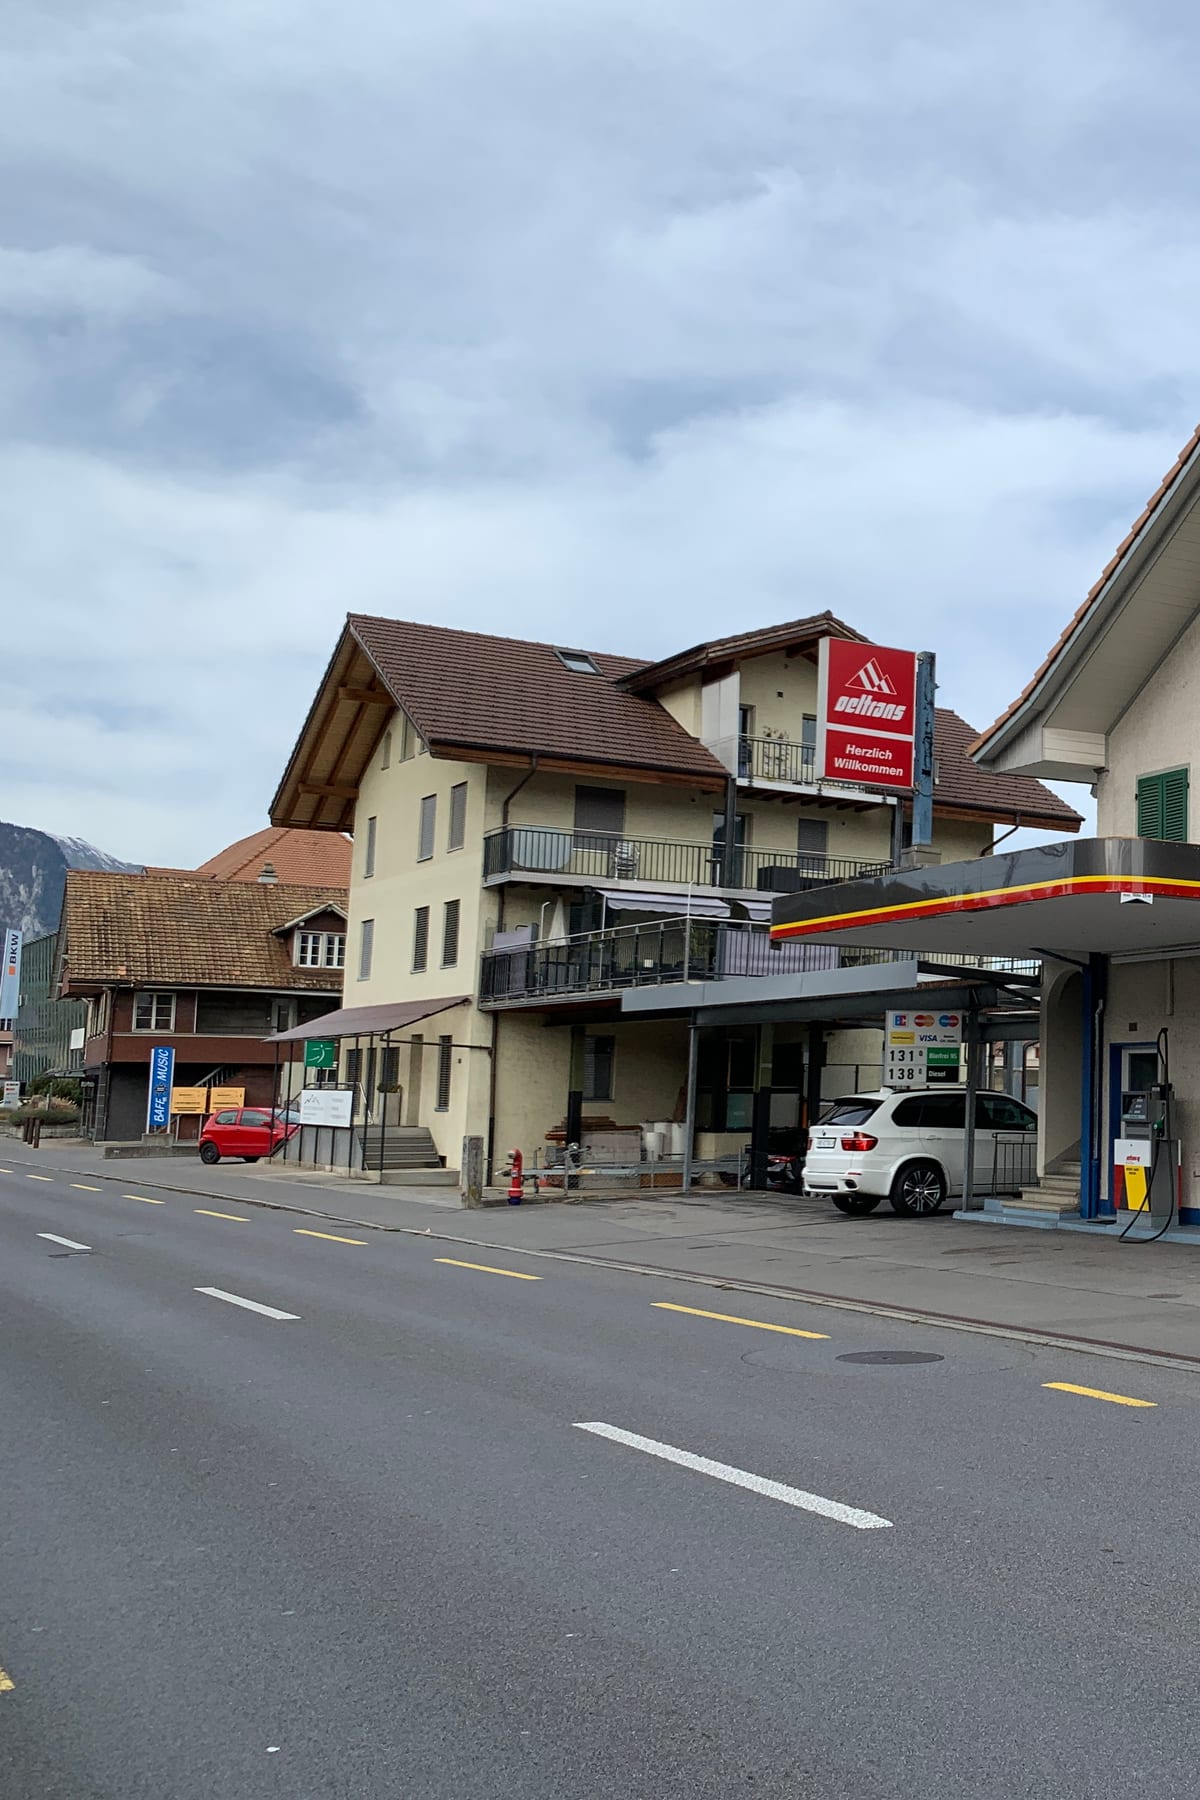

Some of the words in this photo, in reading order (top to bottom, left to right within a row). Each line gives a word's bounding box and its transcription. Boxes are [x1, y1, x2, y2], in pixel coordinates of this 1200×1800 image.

[834, 694, 906, 721] oeltrans
[846, 744, 892, 760] Herzlich
[834, 757, 903, 776] Willkommen
[9, 933, 19, 964] BKW
[919, 1034, 938, 1042] VISA
[890, 1050, 914, 1062] 131
[156, 1049, 169, 1081] MUSIC
[889, 1068, 914, 1080] 138
